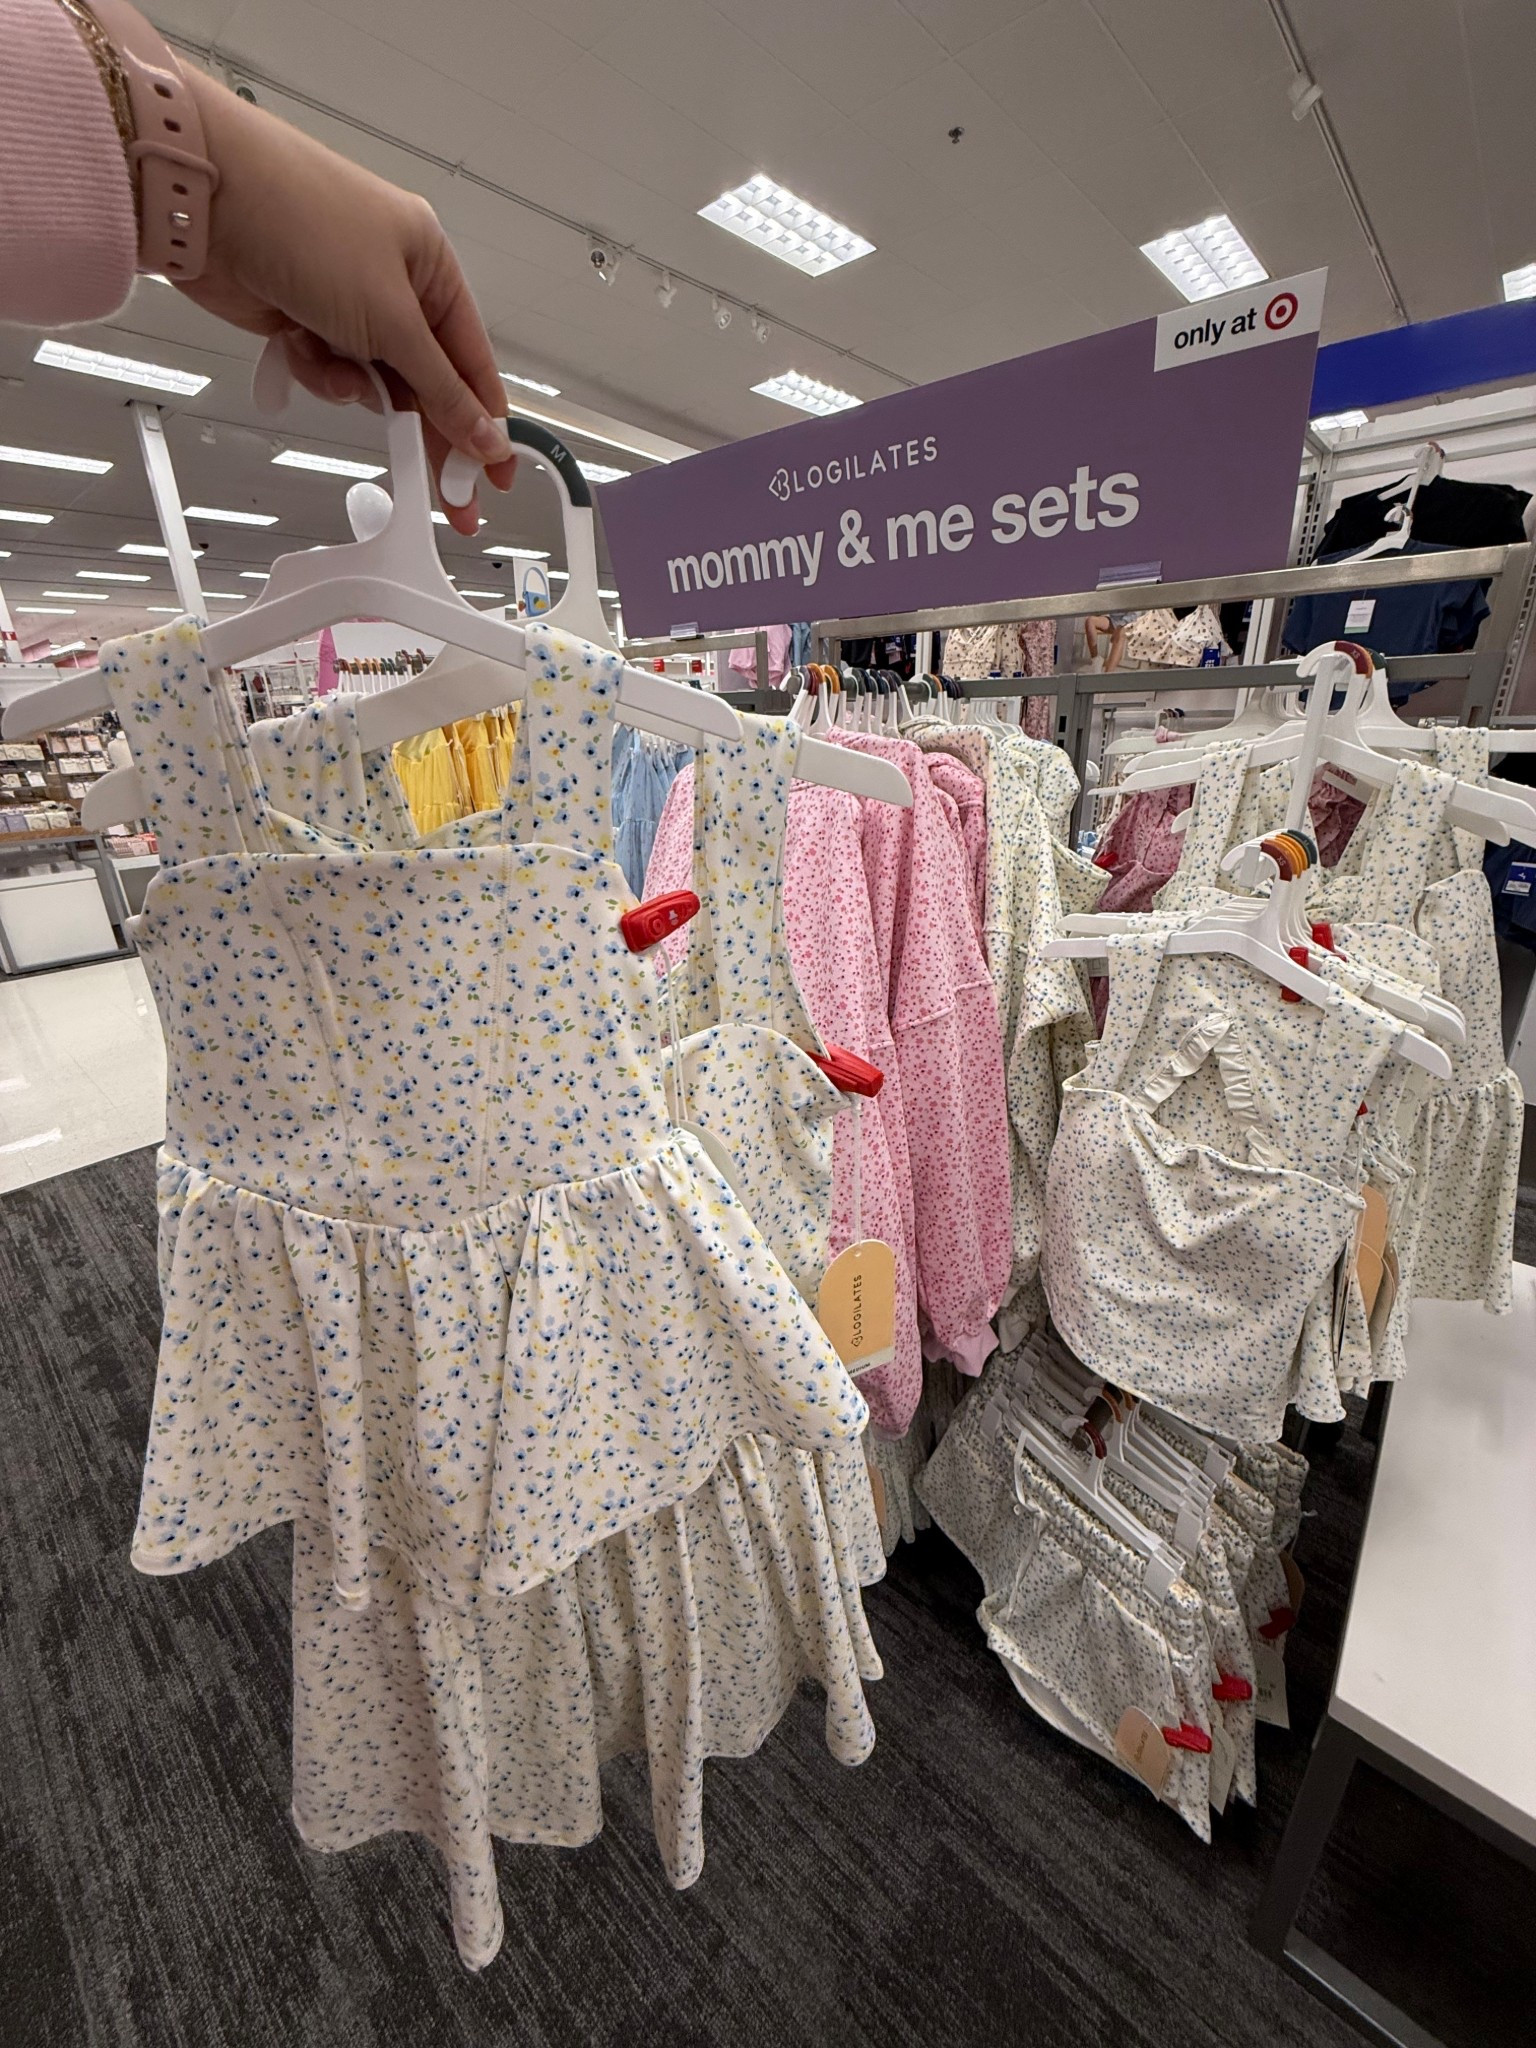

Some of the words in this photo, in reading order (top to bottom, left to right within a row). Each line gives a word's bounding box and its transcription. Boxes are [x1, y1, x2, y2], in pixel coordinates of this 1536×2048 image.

[1174, 318, 1226, 349] only
[1230, 307, 1258, 335] at
[550, 444, 567, 463] M
[768, 436, 938, 501] BLOGILATES
[667, 530, 824, 594] mommy
[837, 509, 876, 568] &
[886, 503, 974, 561] me
[991, 465, 1140, 544] sets
[851, 1274, 864, 1348] BLOGILATES
